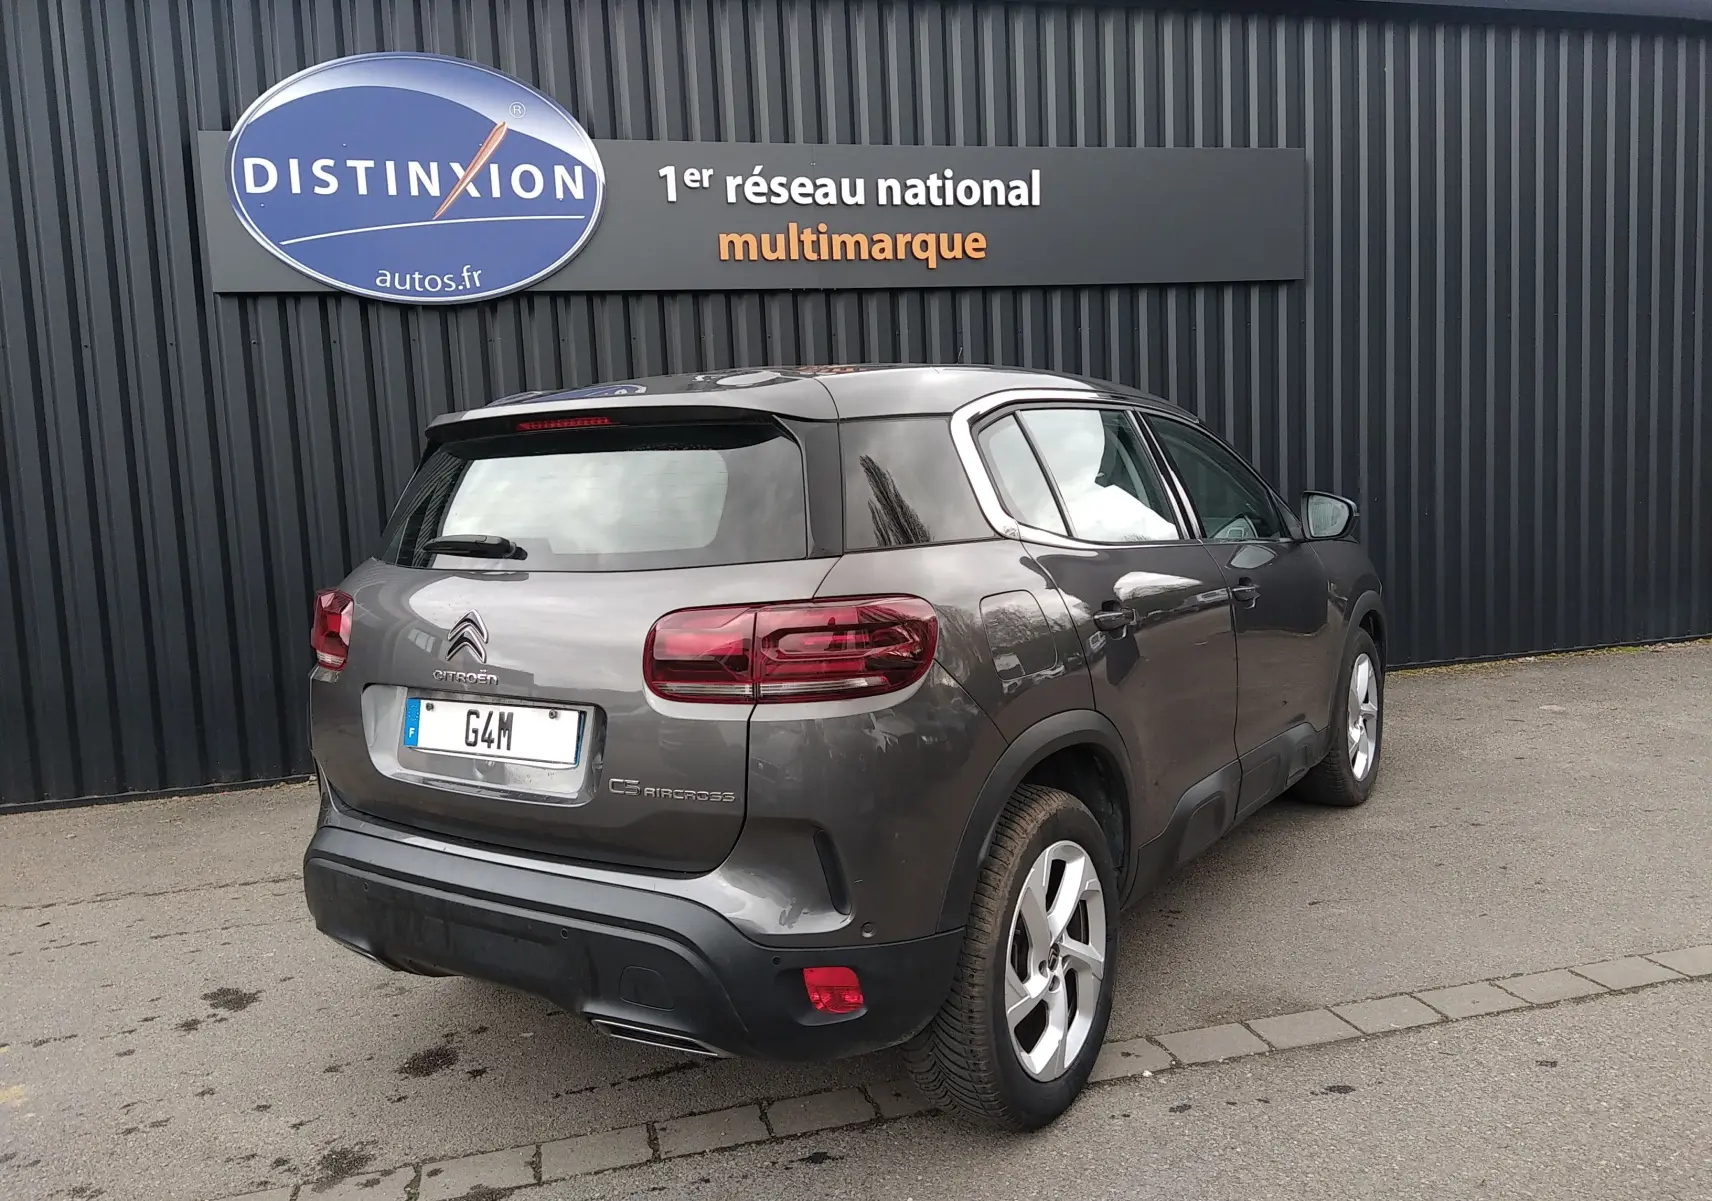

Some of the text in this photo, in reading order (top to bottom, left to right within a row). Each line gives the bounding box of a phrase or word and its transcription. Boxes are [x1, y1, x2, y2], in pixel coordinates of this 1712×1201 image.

[242, 156, 585, 201] DISTINXION
[725, 165, 865, 206] réseau
[878, 168, 1041, 206] national
[718, 222, 987, 269] multimarque
[375, 264, 482, 292] autos.fr
[408, 728, 415, 738] F
[465, 709, 514, 750] G4M
[609, 778, 735, 802] C5 AIRCROSS
